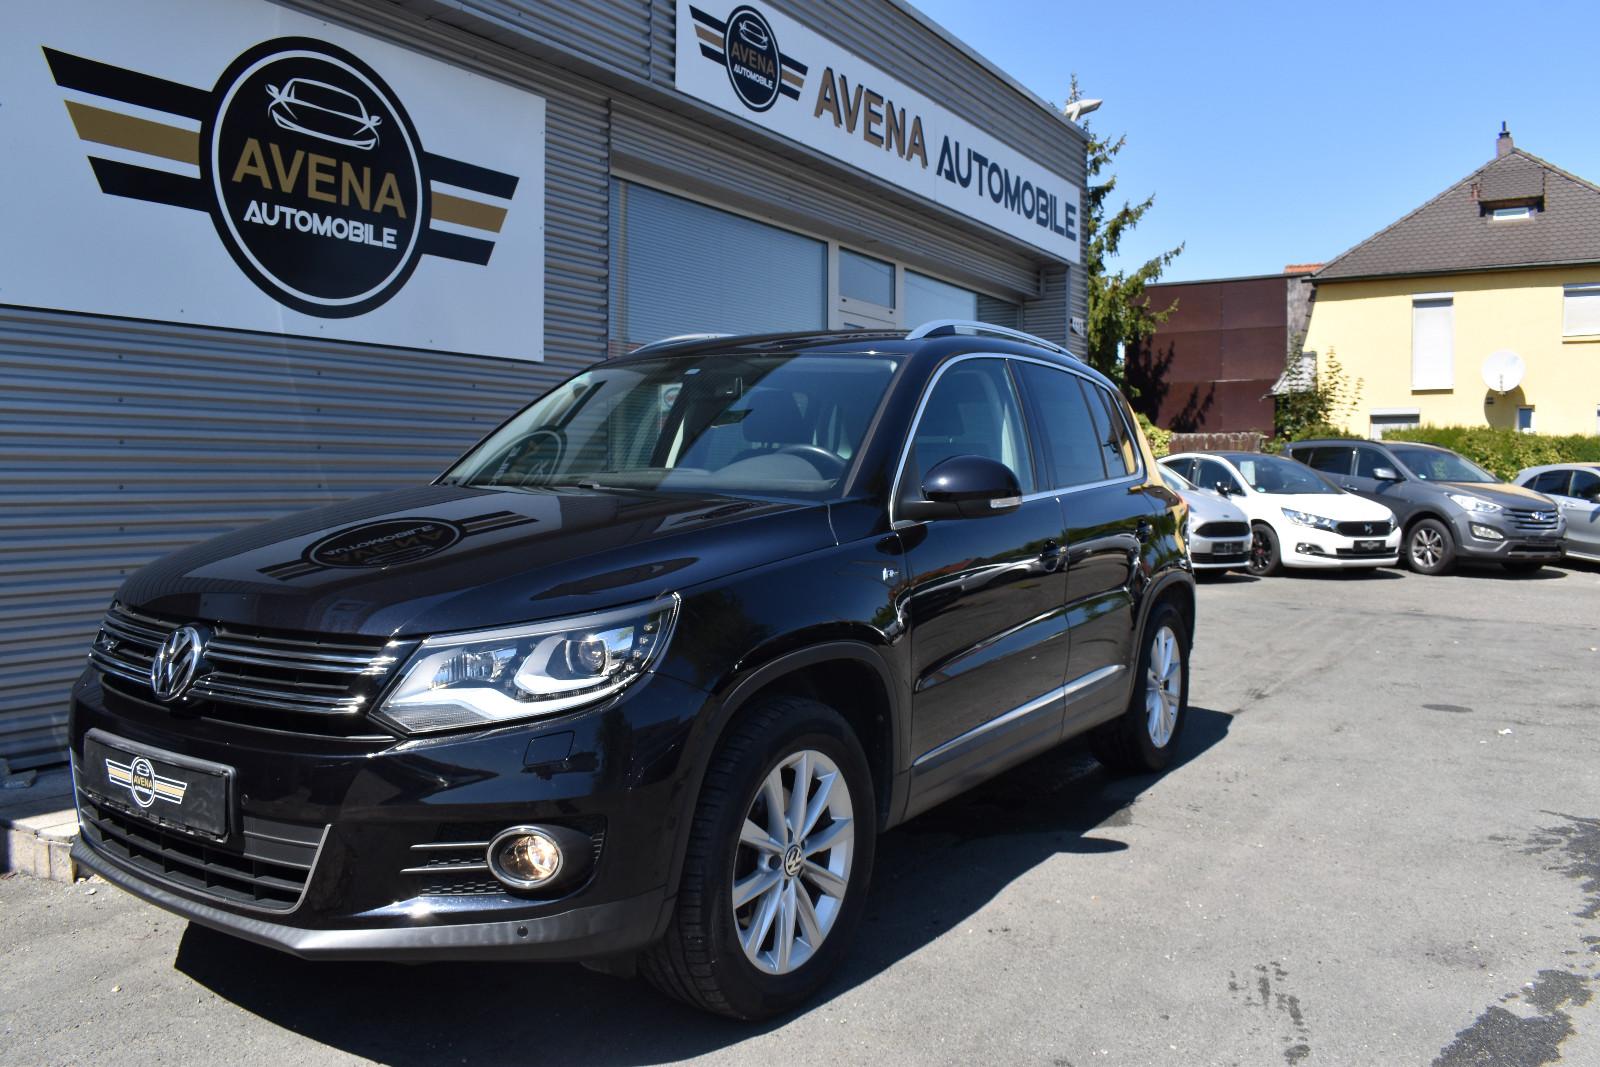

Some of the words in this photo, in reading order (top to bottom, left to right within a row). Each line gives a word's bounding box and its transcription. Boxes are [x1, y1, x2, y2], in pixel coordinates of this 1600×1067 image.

[731, 41, 775, 78] AVENA
[733, 64, 773, 90] AUTOMOBILE
[814, 66, 928, 169] AVENA
[936, 135, 1077, 242] AUTOMOBILE
[232, 137, 407, 219] AVENA
[243, 200, 398, 249] AUTOMOBILE
[133, 774, 153, 789] AVENA
